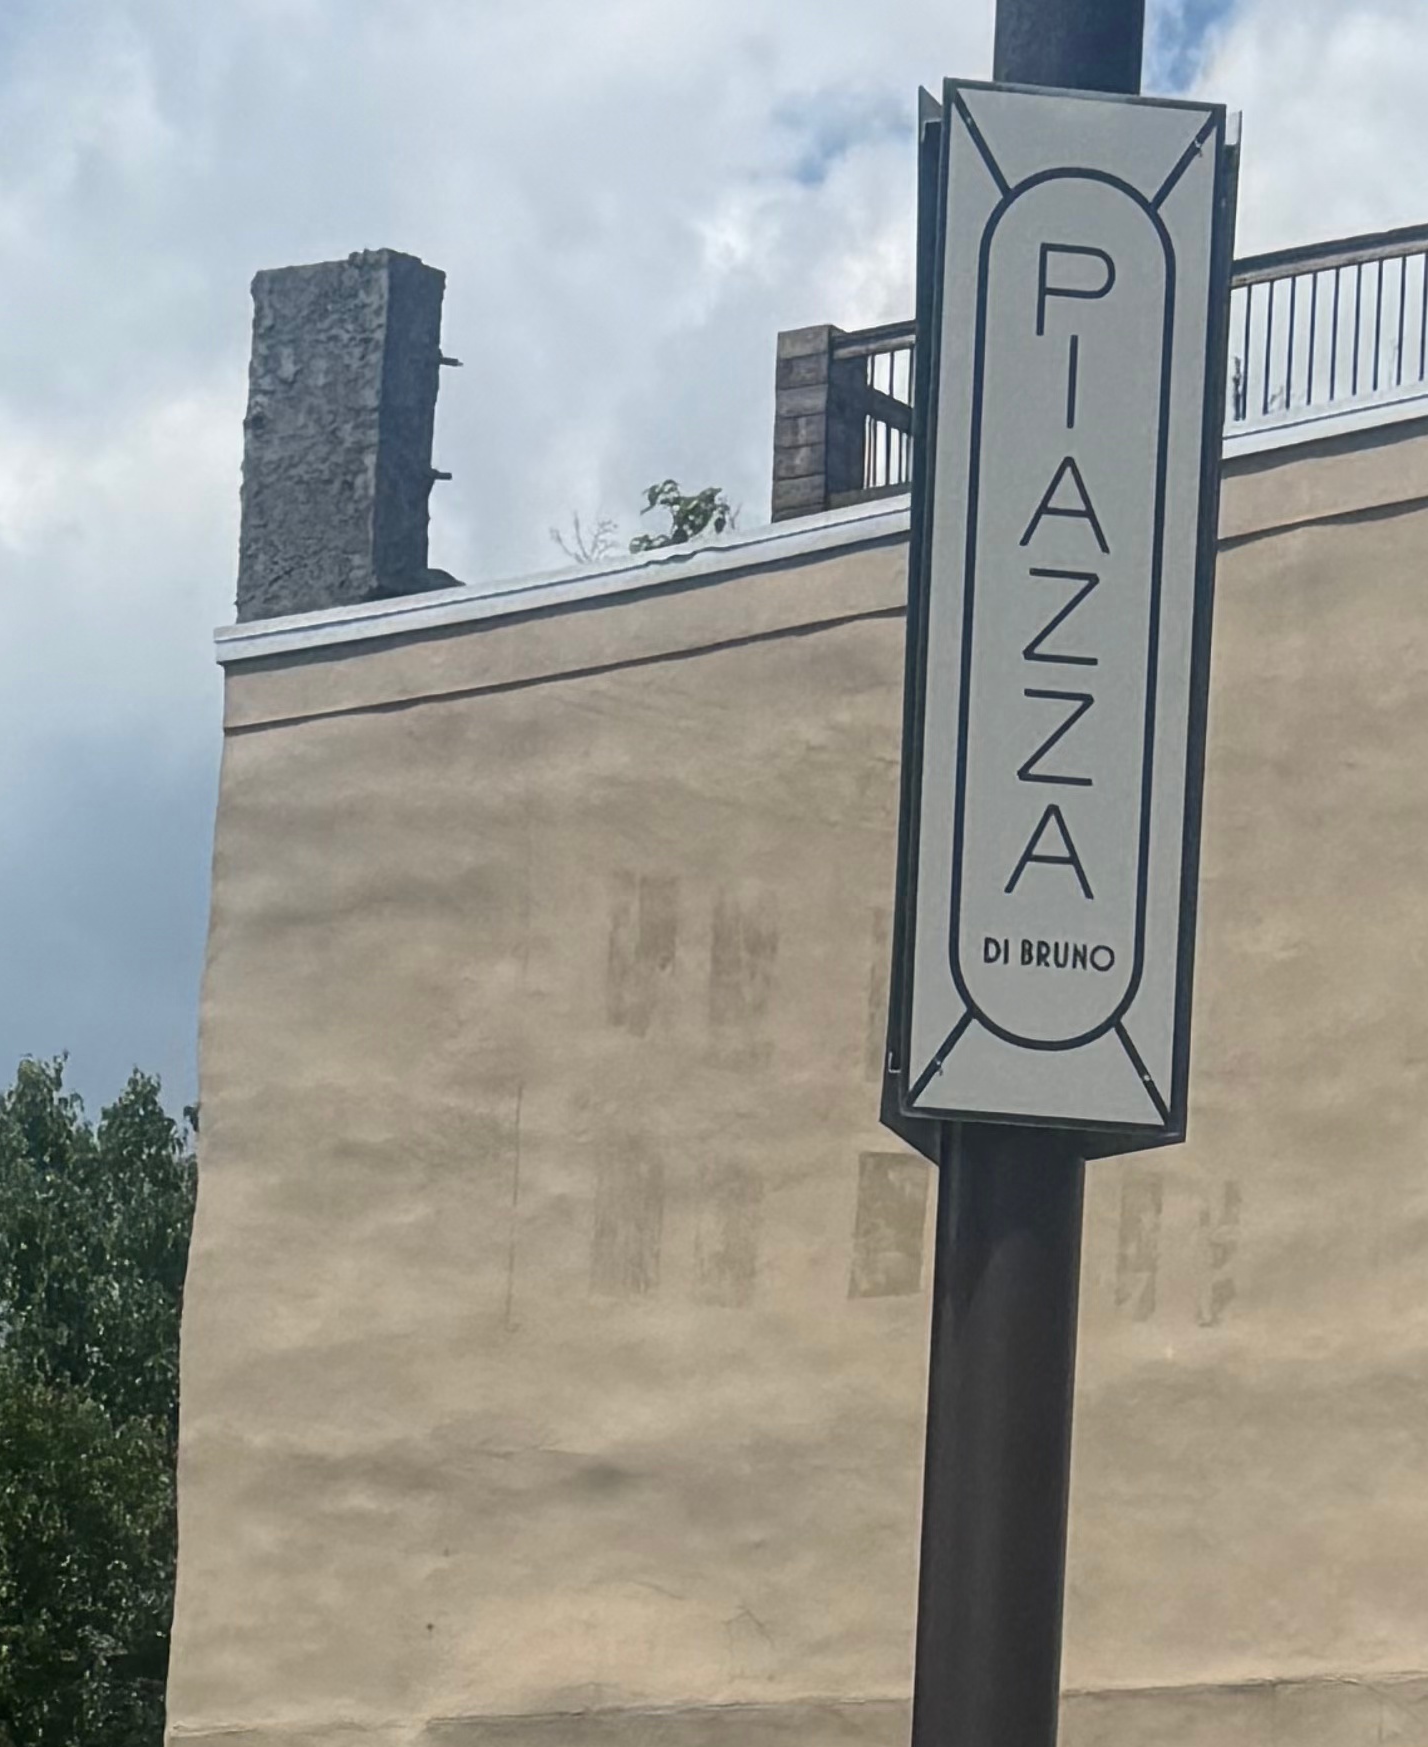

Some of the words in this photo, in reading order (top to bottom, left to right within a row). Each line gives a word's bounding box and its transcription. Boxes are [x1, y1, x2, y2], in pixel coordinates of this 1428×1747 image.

[1004, 242, 1116, 899] PIAZZA
[983, 936, 1009, 965] DI
[1020, 939, 1115, 972] BRUNO
